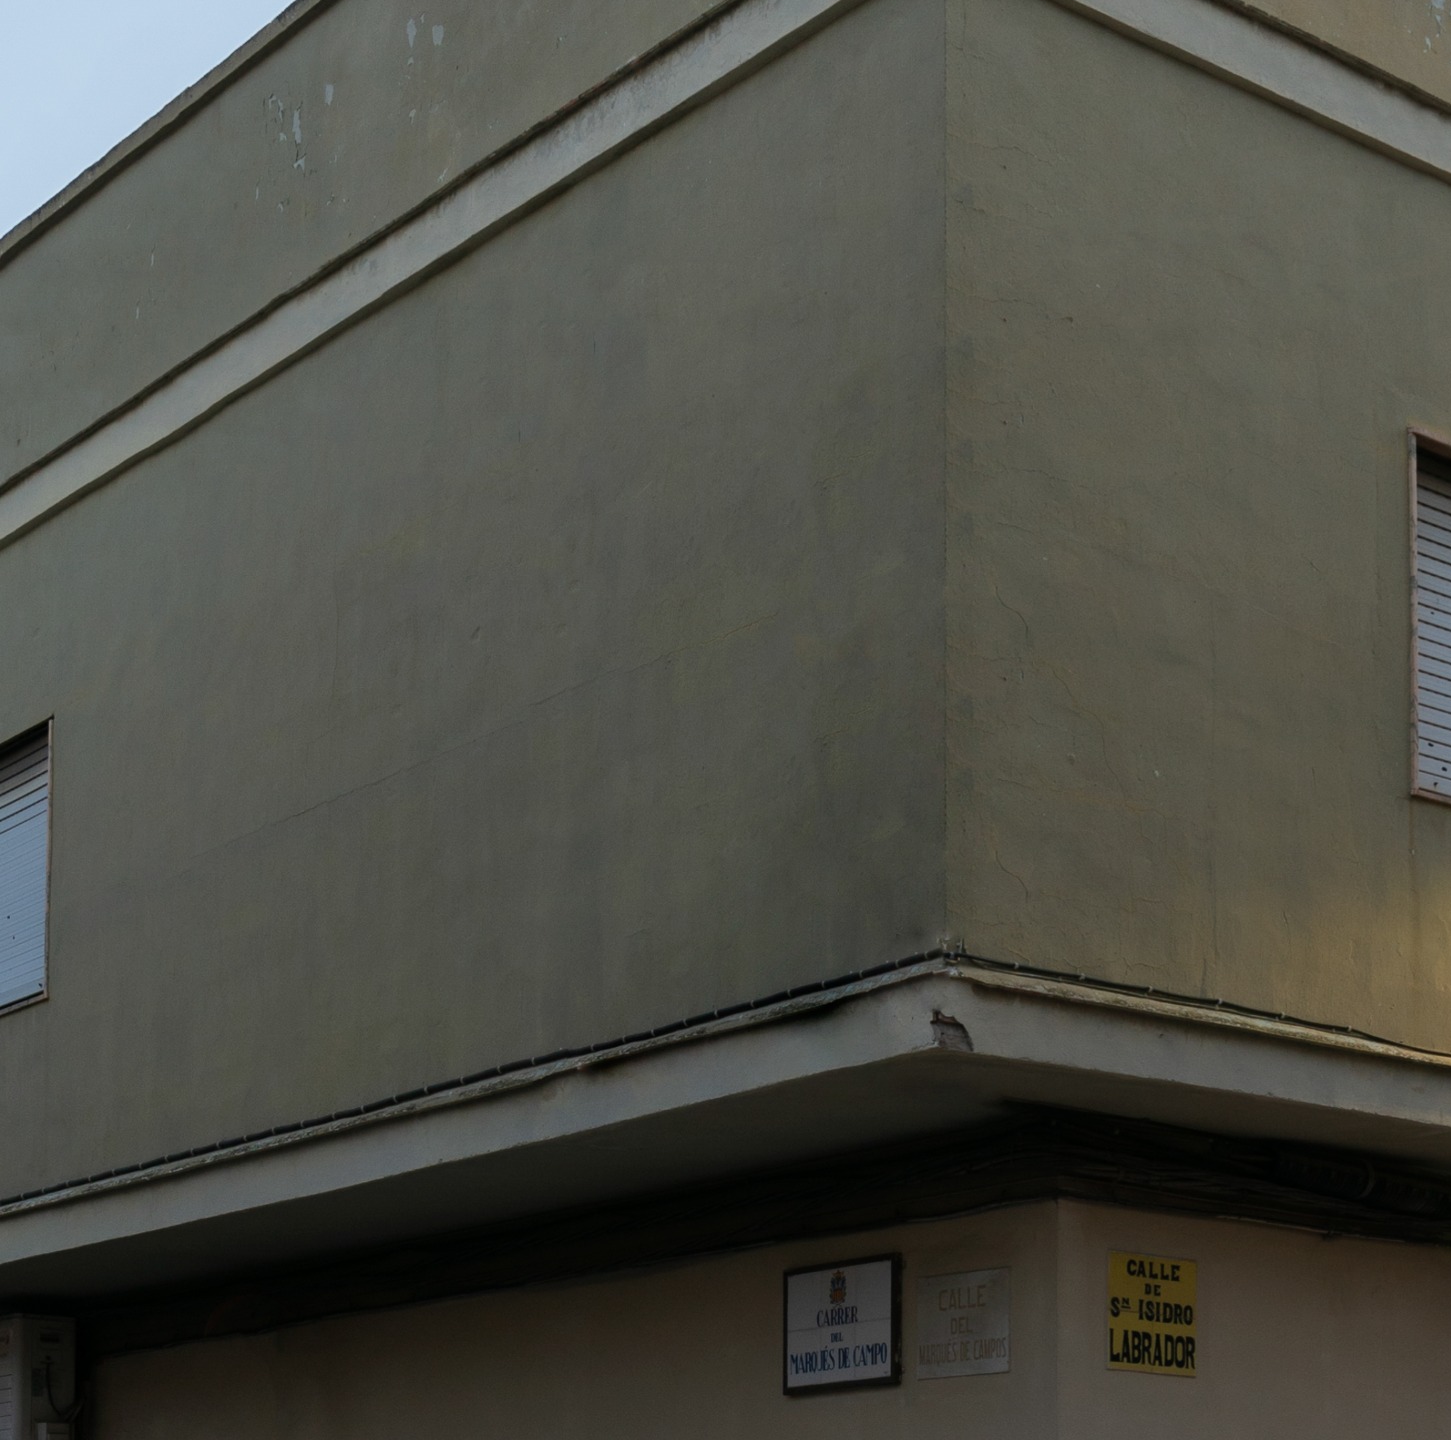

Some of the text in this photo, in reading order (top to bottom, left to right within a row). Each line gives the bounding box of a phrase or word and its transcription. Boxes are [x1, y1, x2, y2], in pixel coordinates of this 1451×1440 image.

[1127, 1259, 1180, 1282] CALLE
[938, 1284, 987, 1311] CALLE
[1144, 1283, 1161, 1296] DE
[816, 1305, 858, 1328] CARRER
[1138, 1299, 1193, 1326] ISIDRO
[950, 1316, 973, 1335] DEL
[830, 1332, 844, 1343] DEL
[960, 1340, 971, 1361] DE
[973, 1337, 1007, 1360] CAMPOS
[1109, 1328, 1196, 1369] LABRADOR
[790, 1342, 888, 1375] MARQUÉS DE CAMPO
